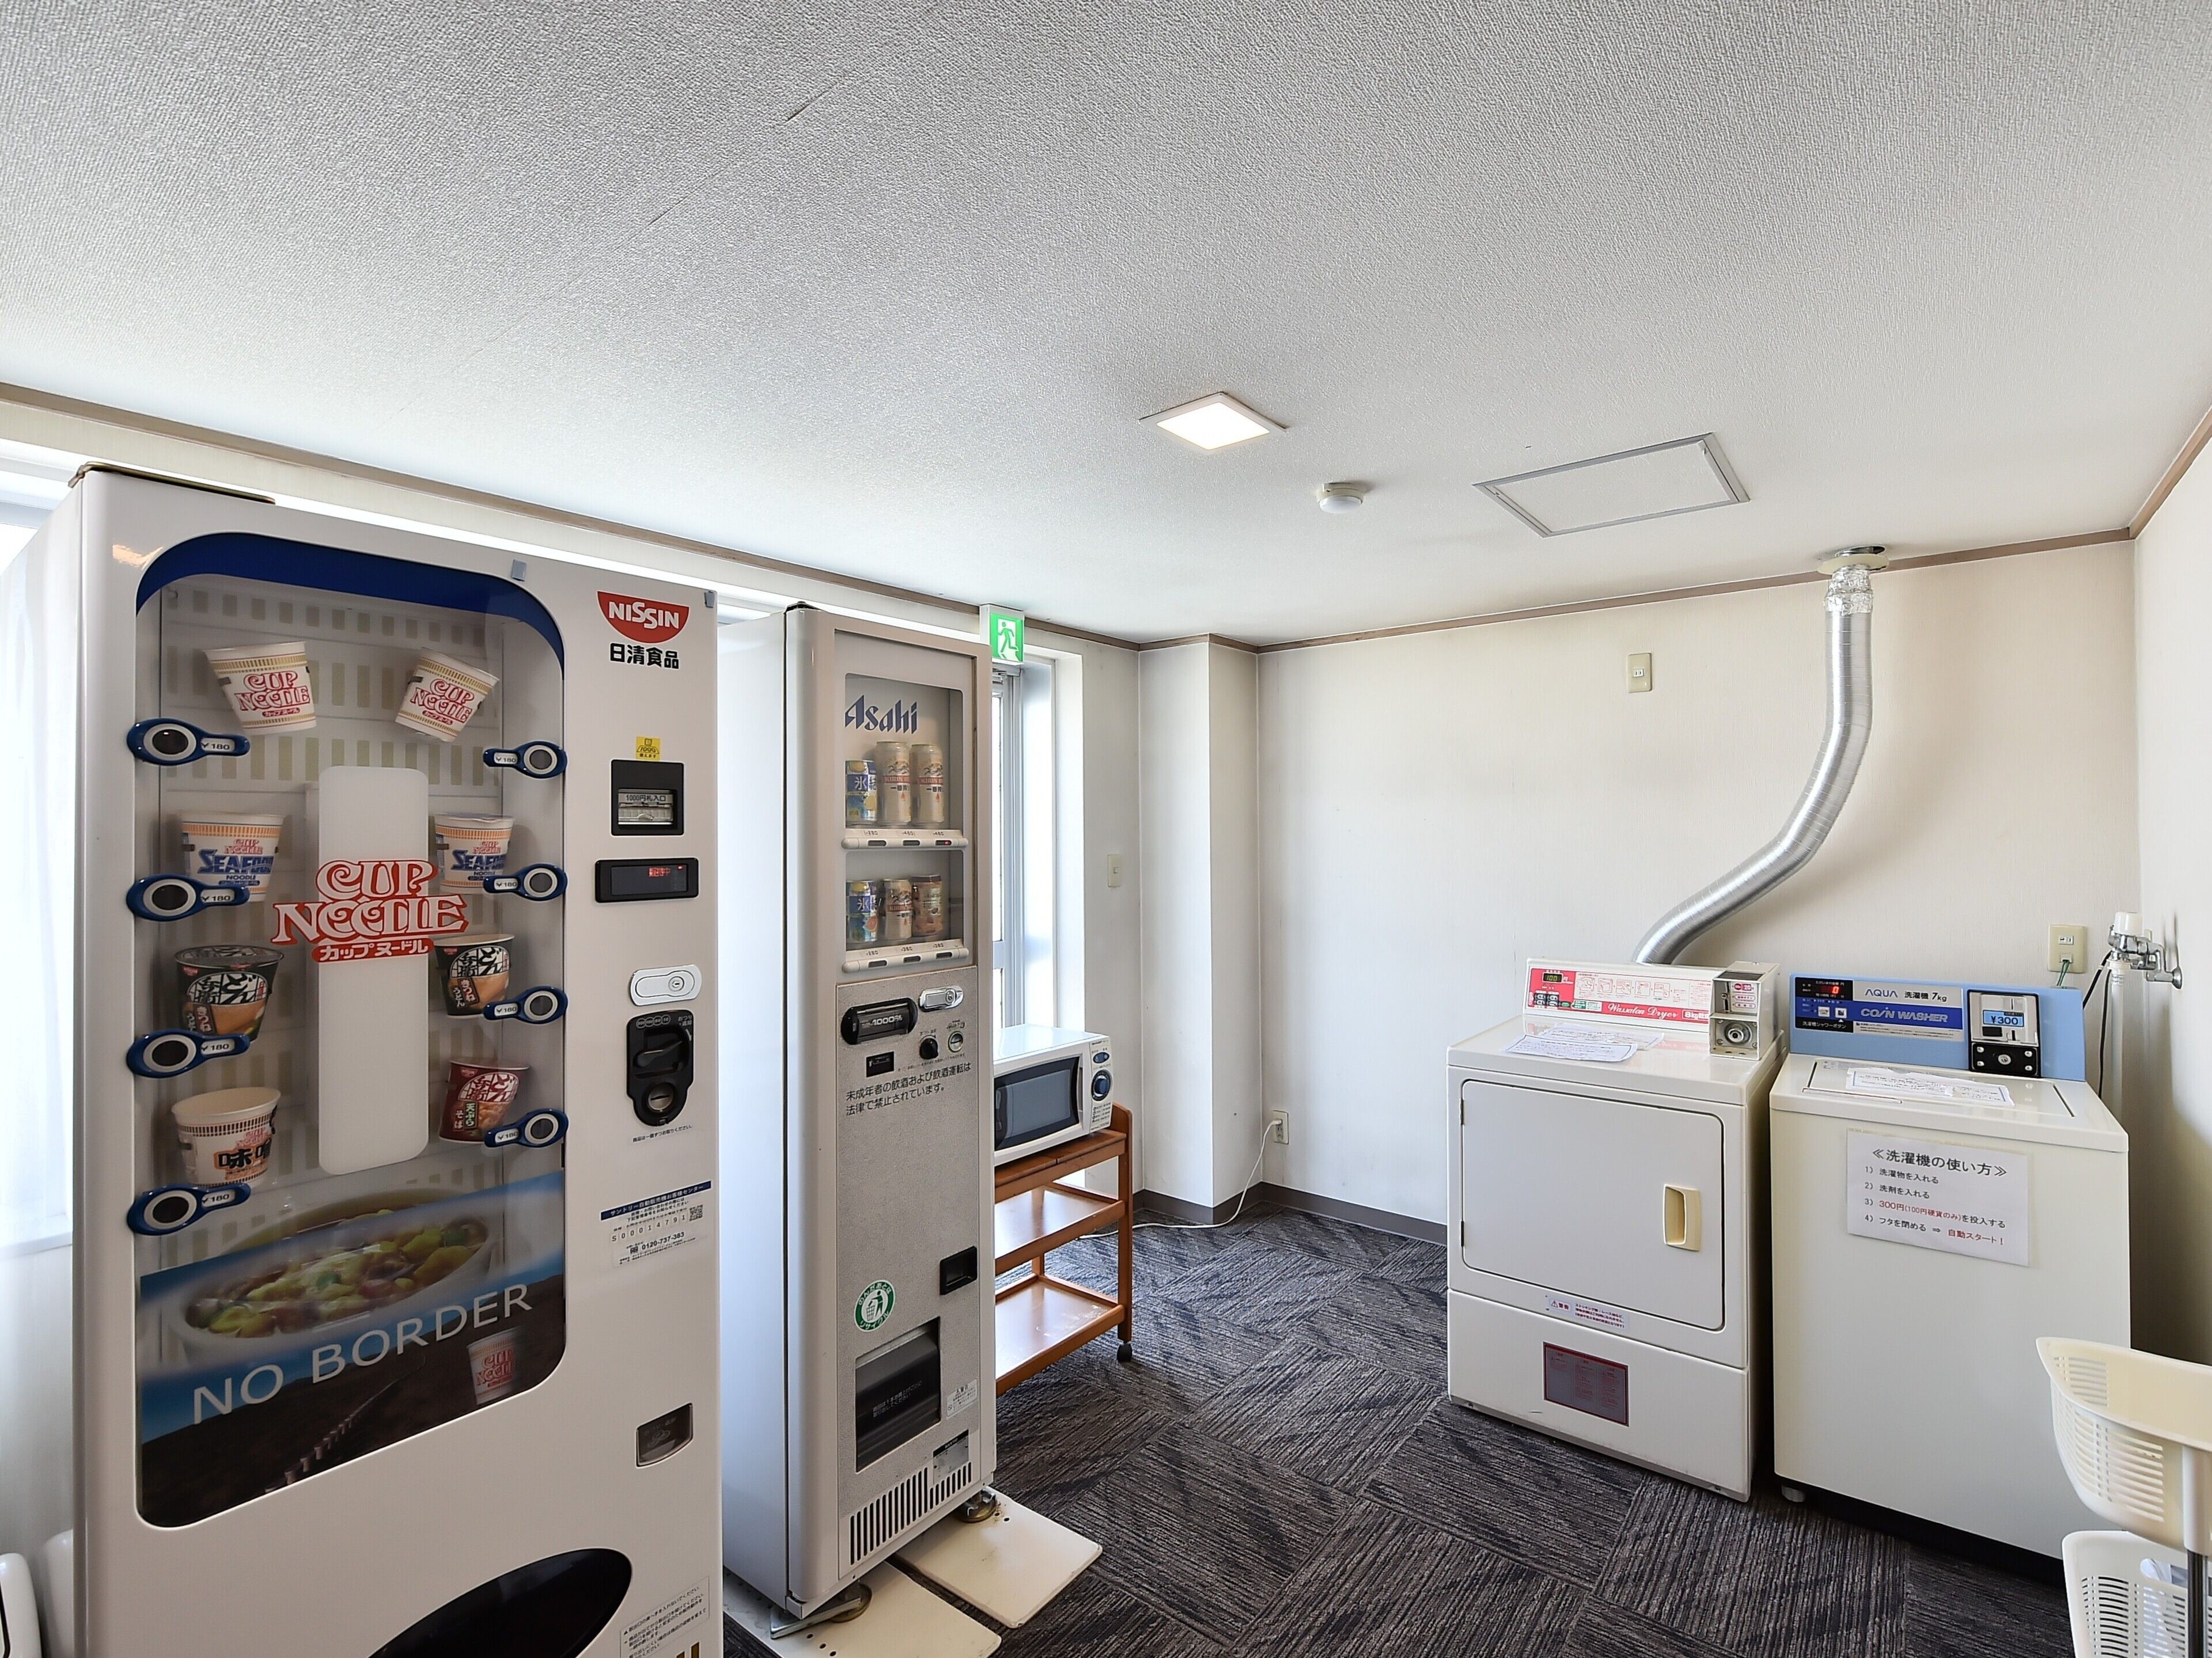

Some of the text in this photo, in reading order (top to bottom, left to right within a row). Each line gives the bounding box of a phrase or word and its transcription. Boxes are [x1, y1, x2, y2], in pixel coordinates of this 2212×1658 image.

[609, 601, 679, 629] NISSIN
[610, 643, 679, 669] 日清食品
[244, 670, 298, 692] CUP
[430, 678, 475, 704] CUP
[234, 685, 310, 711] NOODLE
[410, 687, 472, 723] NOODLE
[844, 695, 917, 734] Asahi
[316, 859, 439, 901] CUP
[271, 894, 469, 946] NOODLE
[319, 940, 429, 962] カップヌードル
[1832, 986, 1839, 994] 0
[1865, 989, 1947, 1002] AQUA 洗濯機 7kg
[1647, 1006, 1678, 1020] Dryer
[1897, 1011, 1948, 1022] WASHER
[1991, 1015, 2018, 1025] ¥300
[846, 1063, 971, 1102] 未成年者の飲酒および飲酒運転は
[846, 1083, 945, 1116] 法律で禁止されています。
[1879, 1168, 1939, 1184] 洗濯物を入れる
[1879, 1184, 1930, 1199] 洗剤を入れる
[1879, 1216, 1926, 1232] フタを閉める
[641, 1231, 684, 1250] 0120-737-383
[858, 1283, 892, 1306] のんだあとは
[859, 1311, 888, 1330] リサイクル
[193, 1284, 533, 1424] NO BORDER
